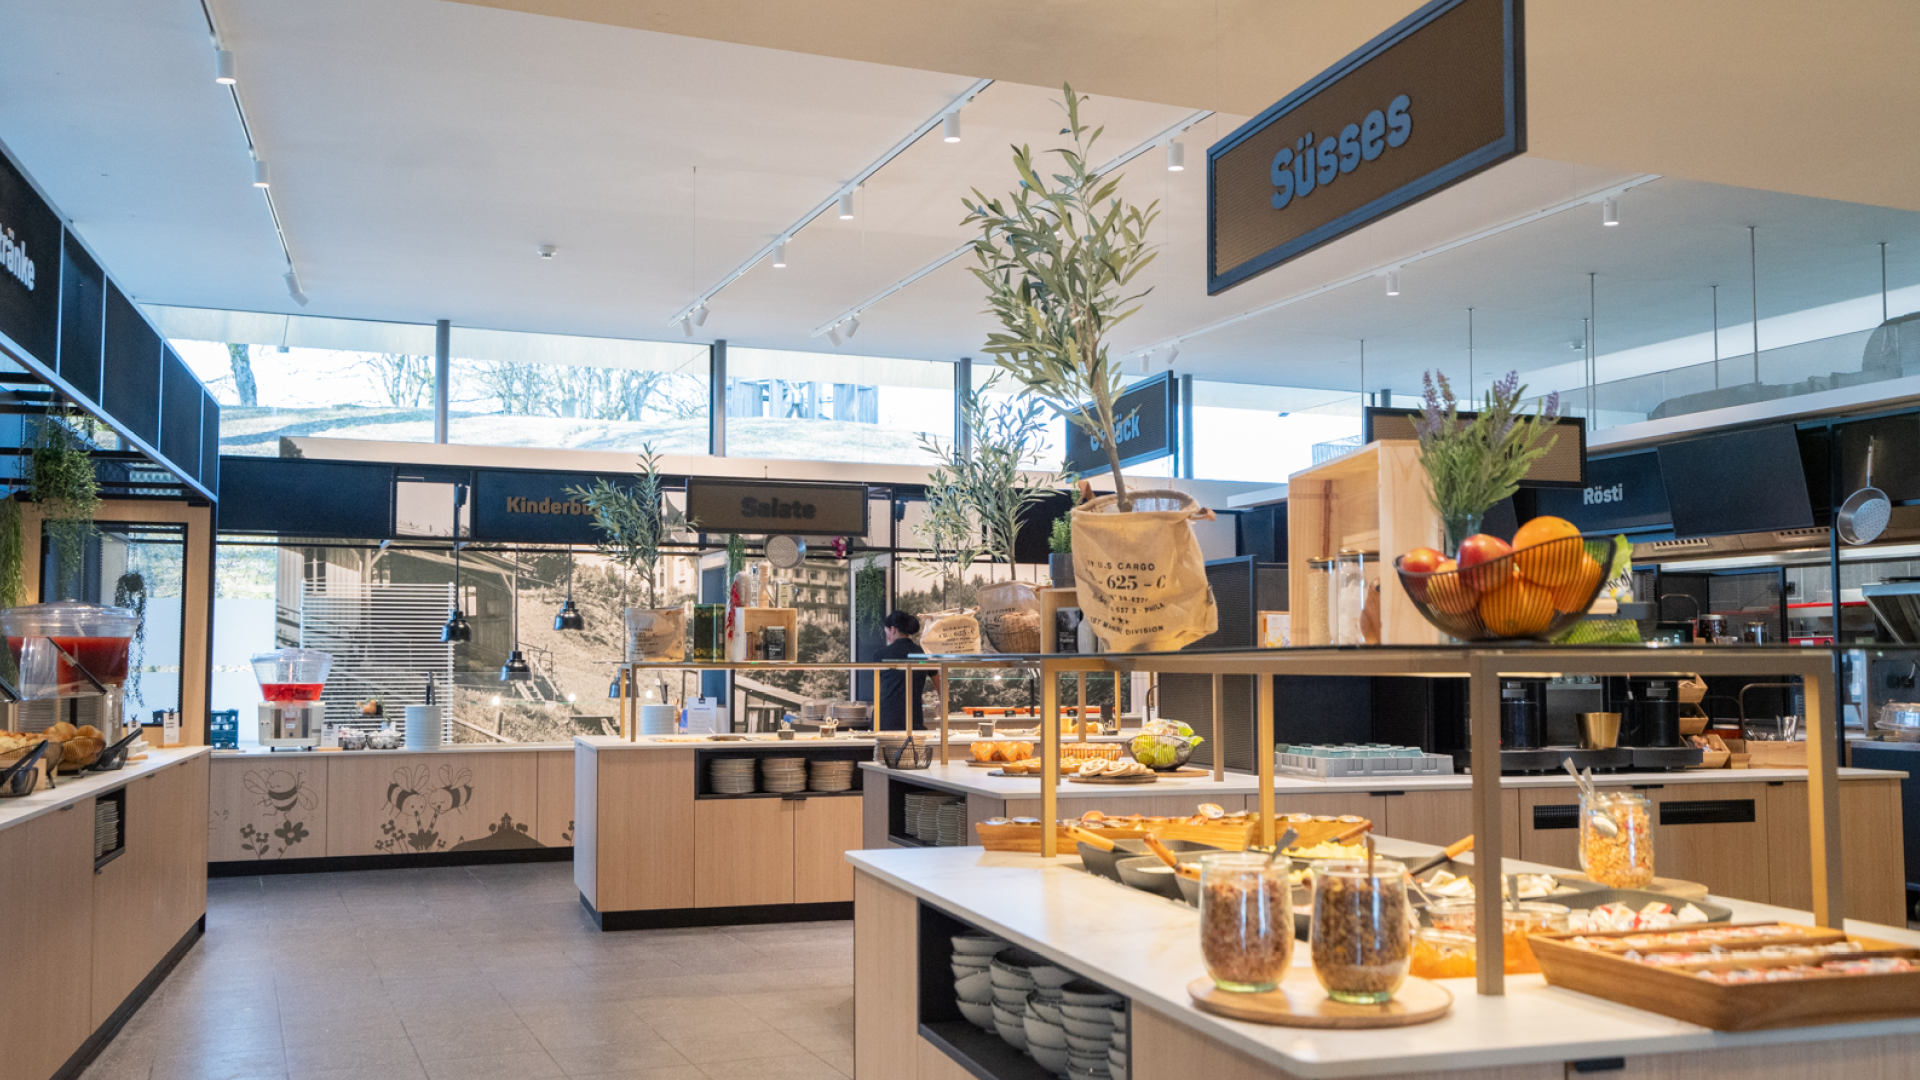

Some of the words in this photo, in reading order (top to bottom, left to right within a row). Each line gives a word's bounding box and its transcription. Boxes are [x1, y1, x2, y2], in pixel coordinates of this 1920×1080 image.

[1271, 94, 1412, 209] Süsses
[1583, 483, 1623, 506] Rösti
[741, 497, 816, 519] Salate
[1116, 562, 1155, 571] CARGO
[1106, 574, 1139, 591] 625
[1156, 574, 1167, 589] C
[1125, 625, 1165, 636] DIVISION
